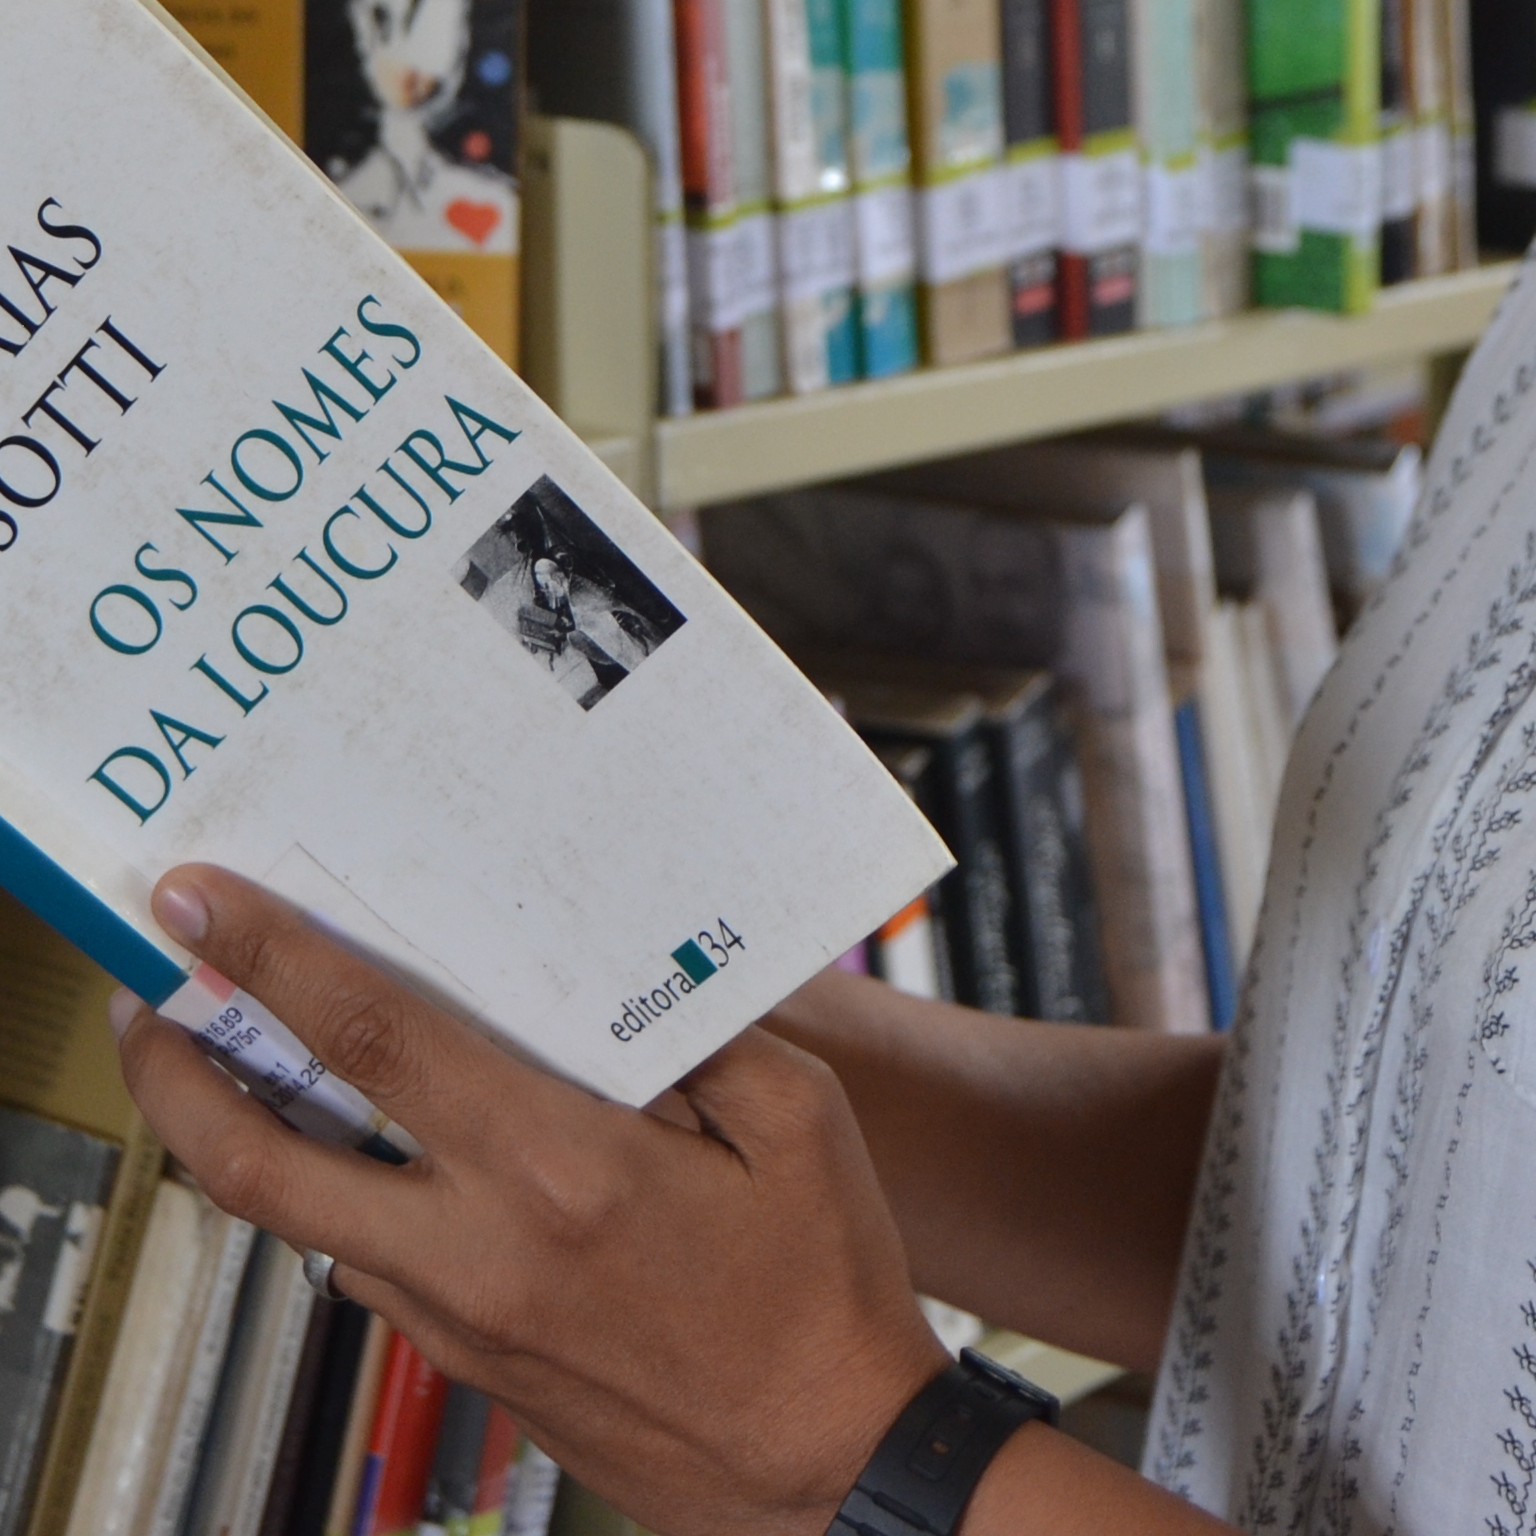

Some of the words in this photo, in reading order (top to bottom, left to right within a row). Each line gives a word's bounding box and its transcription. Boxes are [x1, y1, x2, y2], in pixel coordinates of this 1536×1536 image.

[86, 708, 227, 827] DA
[189, 394, 523, 718] LOUCURA
[89, 541, 199, 655] OS
[175, 294, 421, 566] NOMES
[610, 971, 698, 1043] editora
[697, 916, 746, 968] 34
